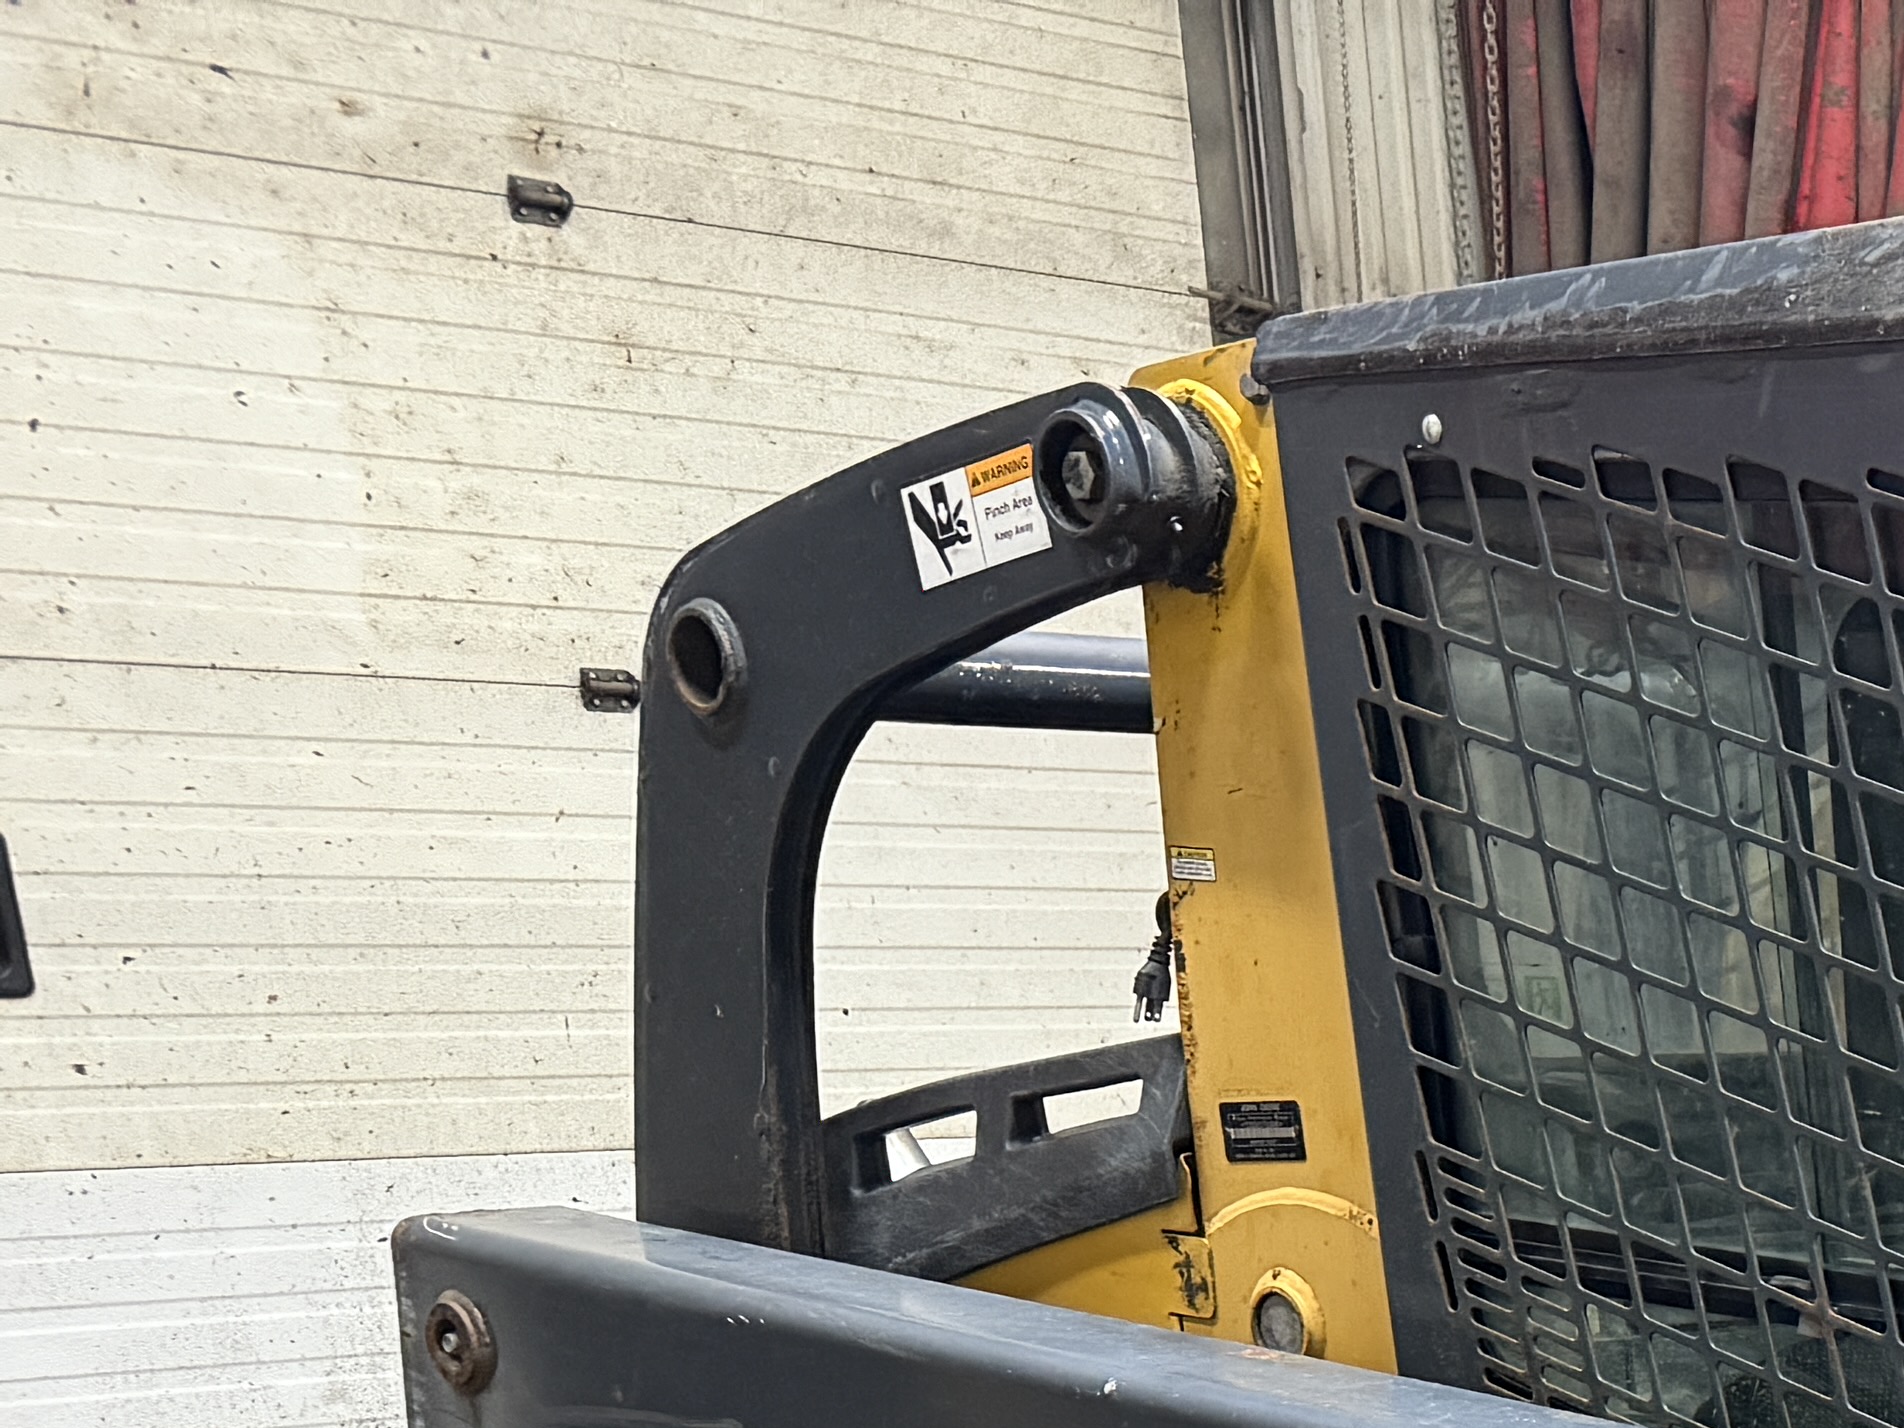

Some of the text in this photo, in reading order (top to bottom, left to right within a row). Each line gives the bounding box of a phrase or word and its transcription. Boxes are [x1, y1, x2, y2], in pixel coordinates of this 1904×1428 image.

[980, 456, 1029, 483] WARNING
[984, 496, 1033, 520] Pinch Area
